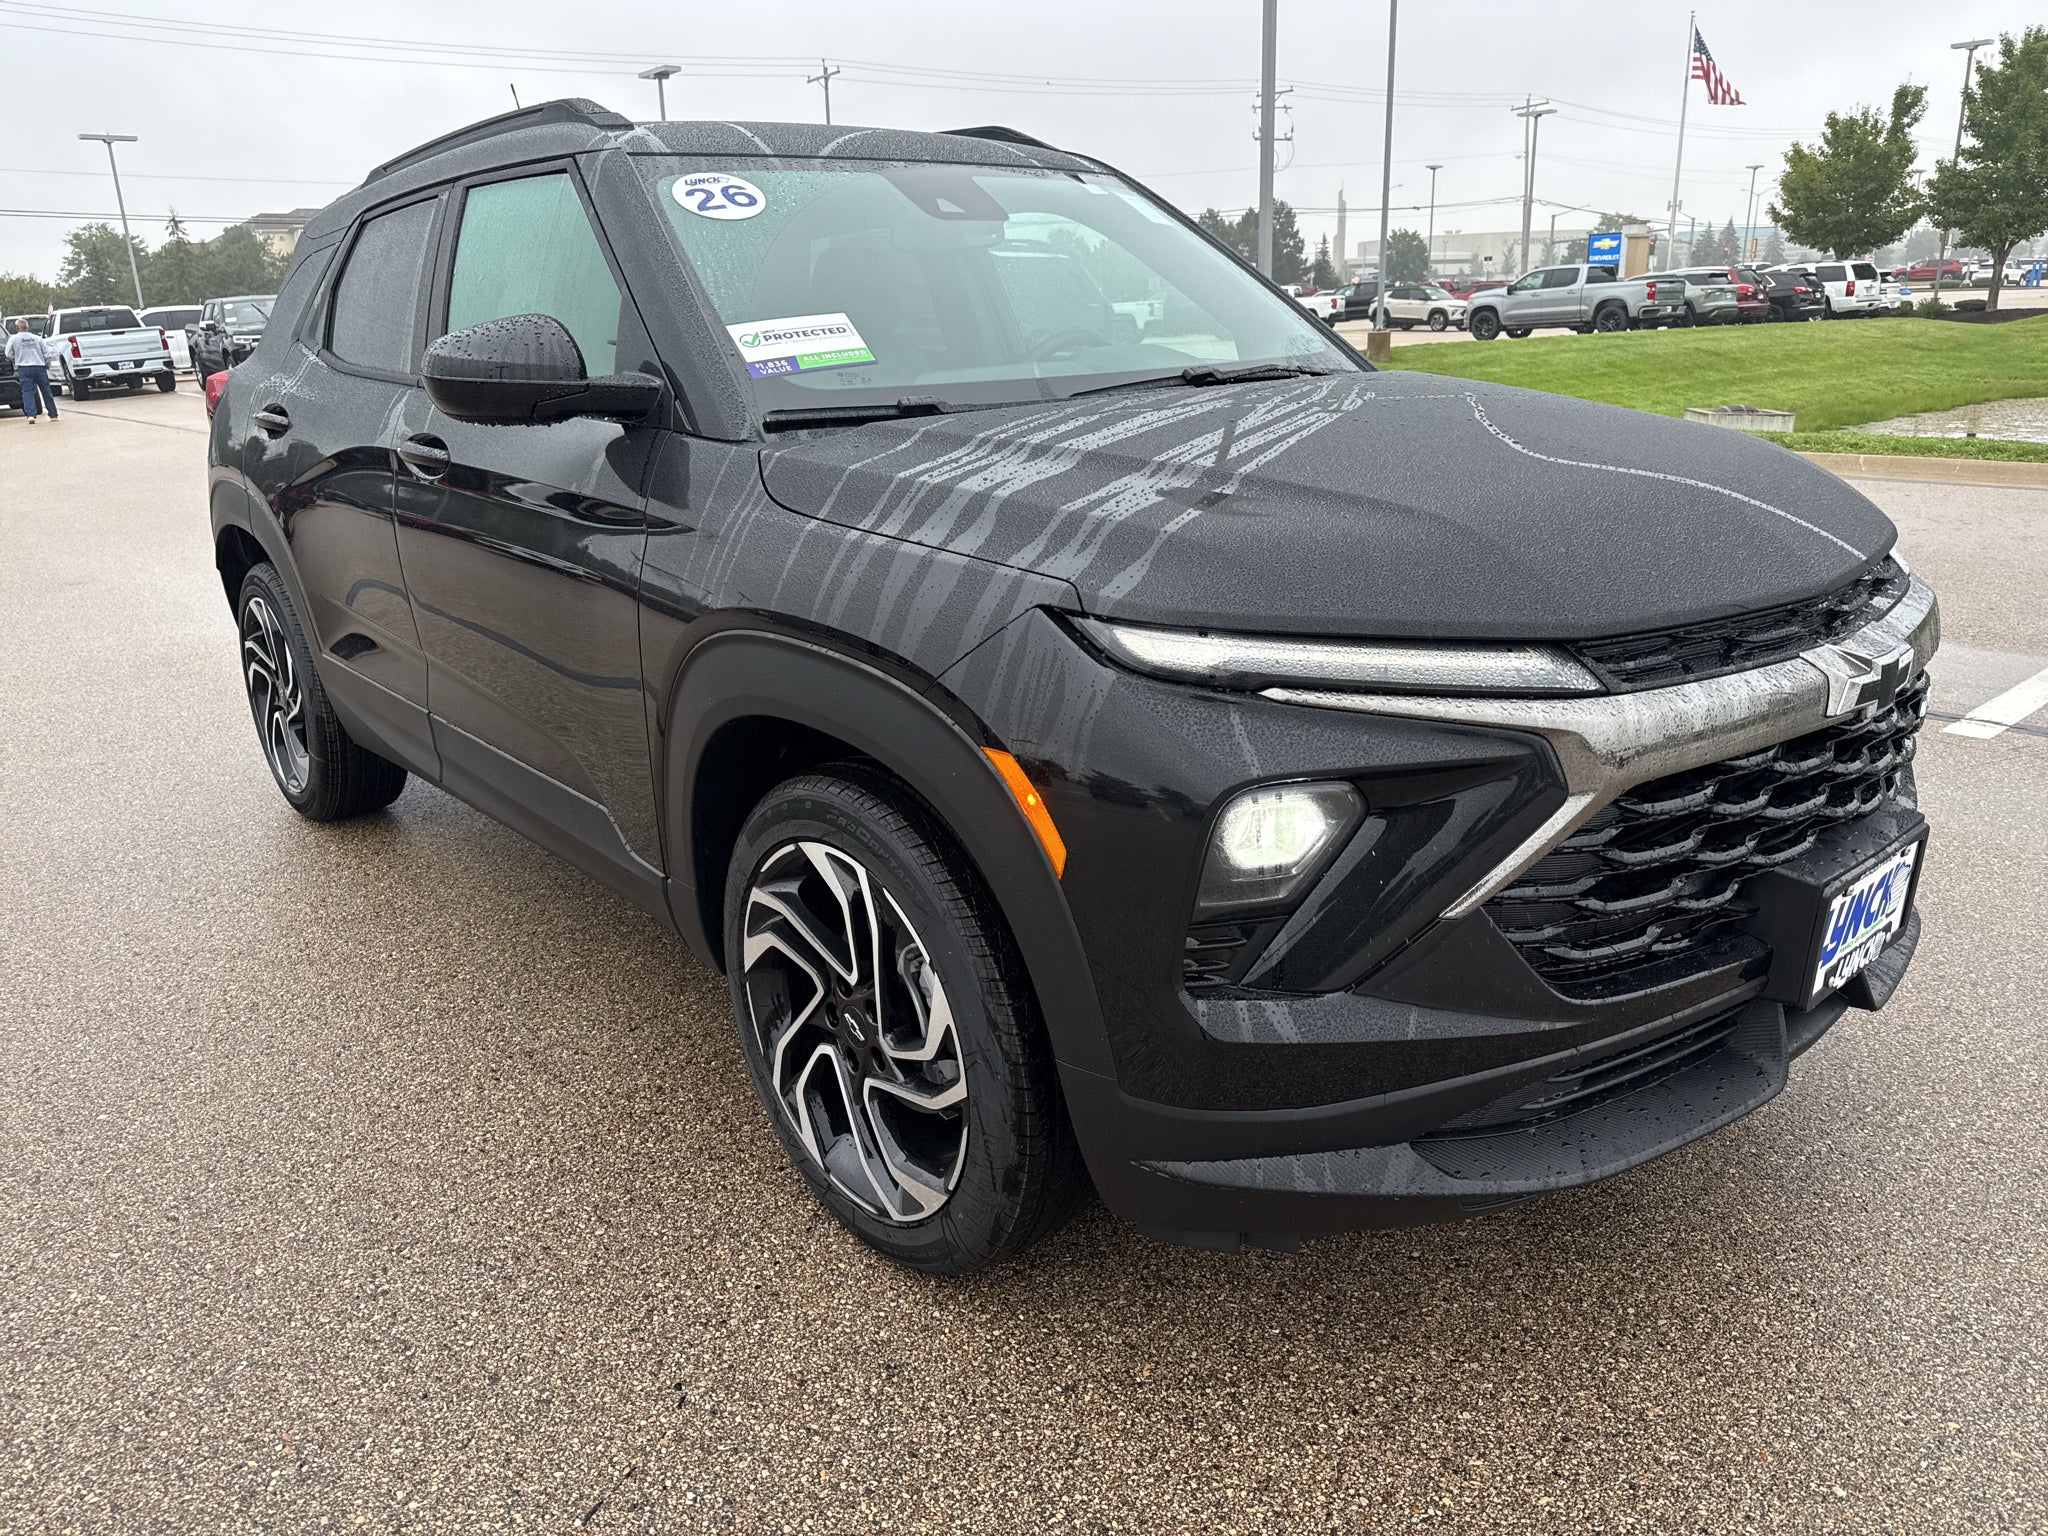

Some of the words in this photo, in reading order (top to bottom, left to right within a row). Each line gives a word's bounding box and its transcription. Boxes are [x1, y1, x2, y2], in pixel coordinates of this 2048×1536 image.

[684, 177, 720, 186] LYNCH
[685, 185, 758, 212] 26
[762, 326, 847, 342] PROTECTED
[821, 349, 867, 360] INCLUDED
[755, 359, 788, 370] $1,836
[760, 365, 793, 375] VALUE
[1820, 863, 1900, 969] LYNCH
[1833, 939, 1879, 989] LYNCH
